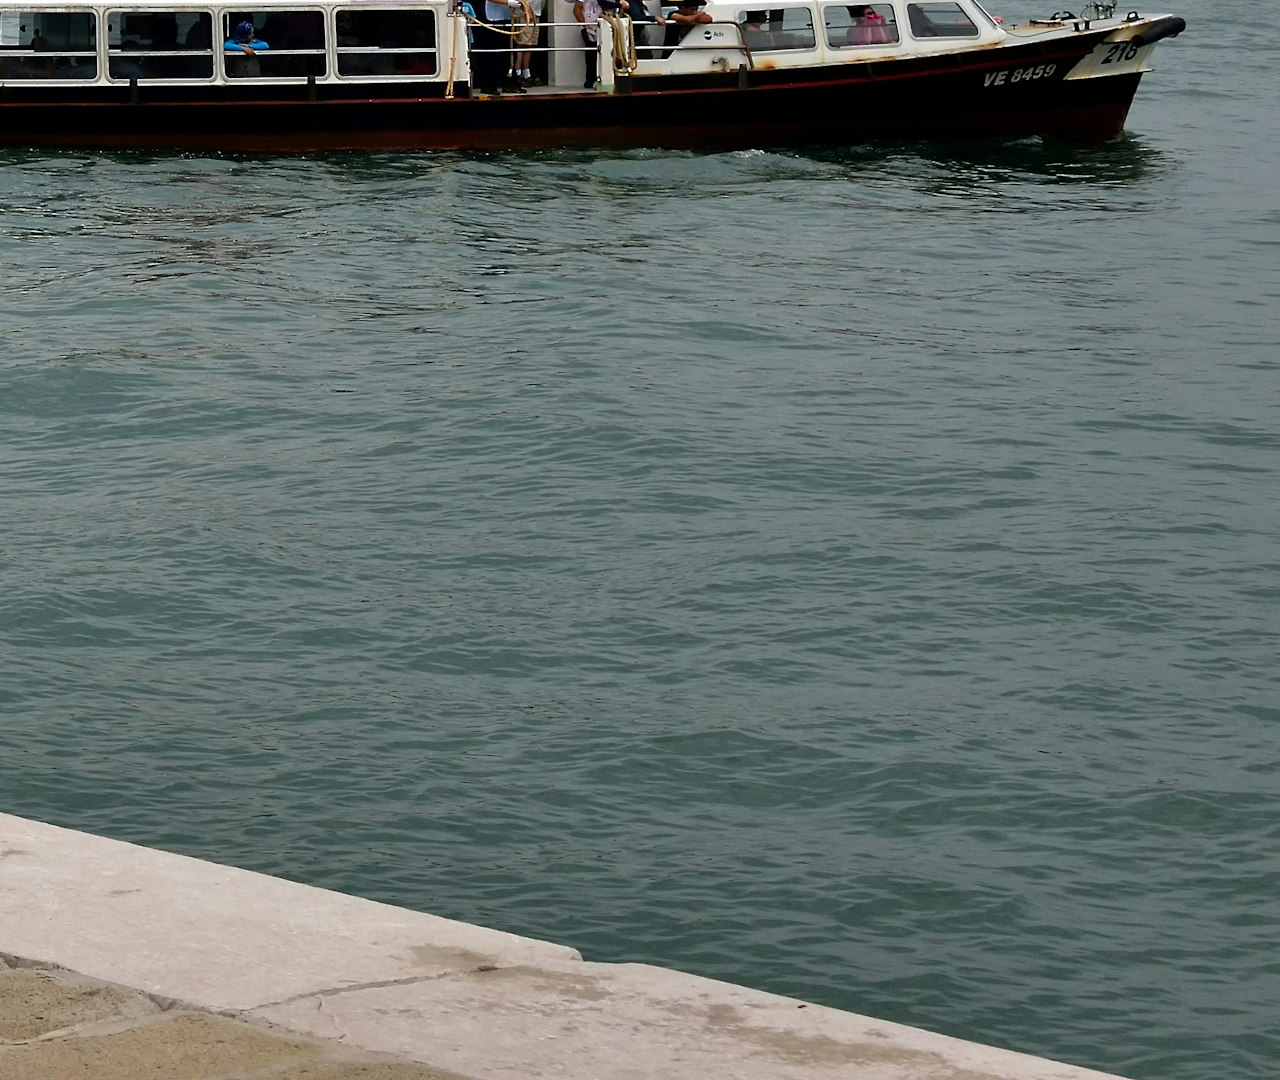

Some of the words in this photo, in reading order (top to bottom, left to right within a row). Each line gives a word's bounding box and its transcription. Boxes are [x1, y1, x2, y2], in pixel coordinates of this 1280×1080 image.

[1100, 43, 1137, 65] 218
[983, 70, 1009, 87] VE
[1010, 63, 1056, 83] 8459
